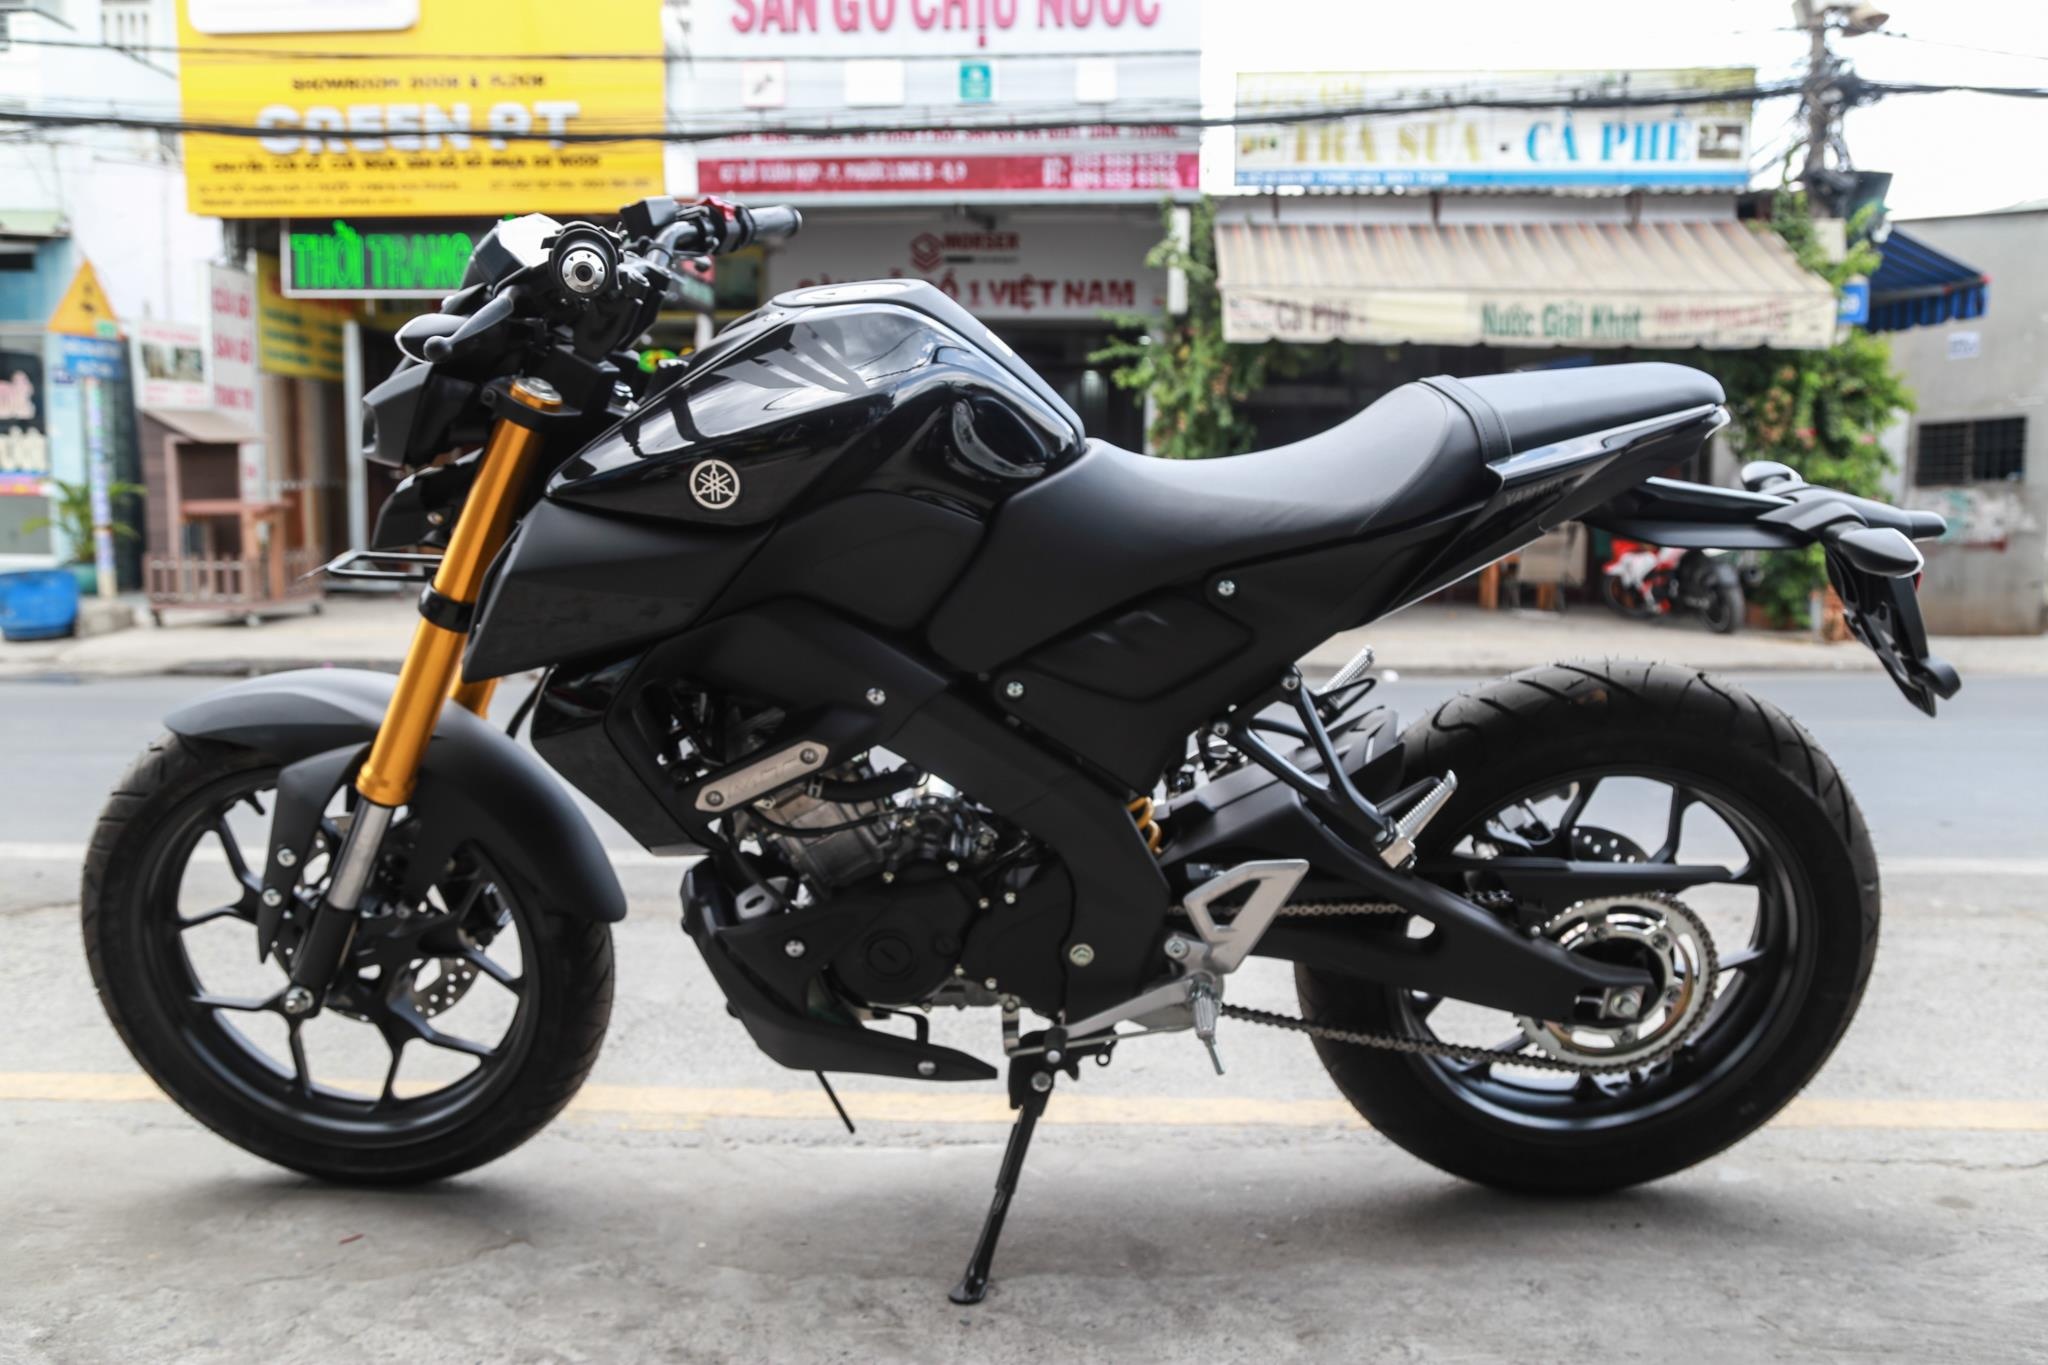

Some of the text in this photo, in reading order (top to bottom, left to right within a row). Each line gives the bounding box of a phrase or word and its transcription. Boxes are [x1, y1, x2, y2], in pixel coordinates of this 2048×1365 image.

[256, 102, 472, 155] GREEN
[989, 273, 1058, 311] VIỆT
[1063, 280, 1136, 306] NAM
